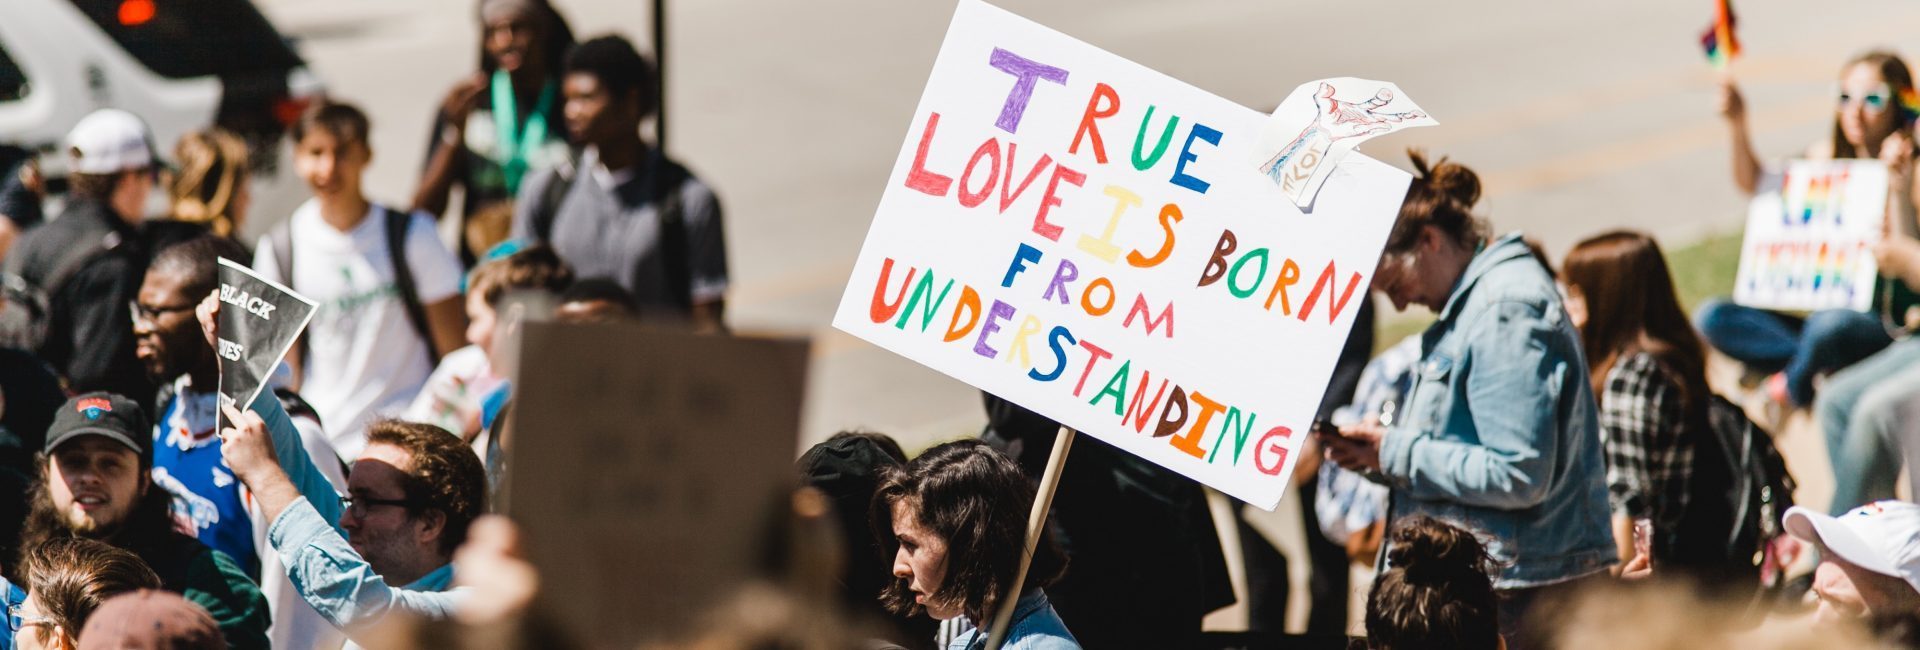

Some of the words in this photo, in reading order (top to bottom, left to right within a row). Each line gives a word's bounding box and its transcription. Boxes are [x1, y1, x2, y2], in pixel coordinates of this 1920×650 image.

[989, 46, 1223, 194] TRUE
[904, 112, 1087, 242] LOVE
[1076, 184, 1184, 269] IS
[1196, 228, 1363, 326] BORN
[1001, 242, 1175, 340] FROM
[220, 283, 276, 320] BLACK
[869, 257, 1293, 477] UNDERSTANDING
